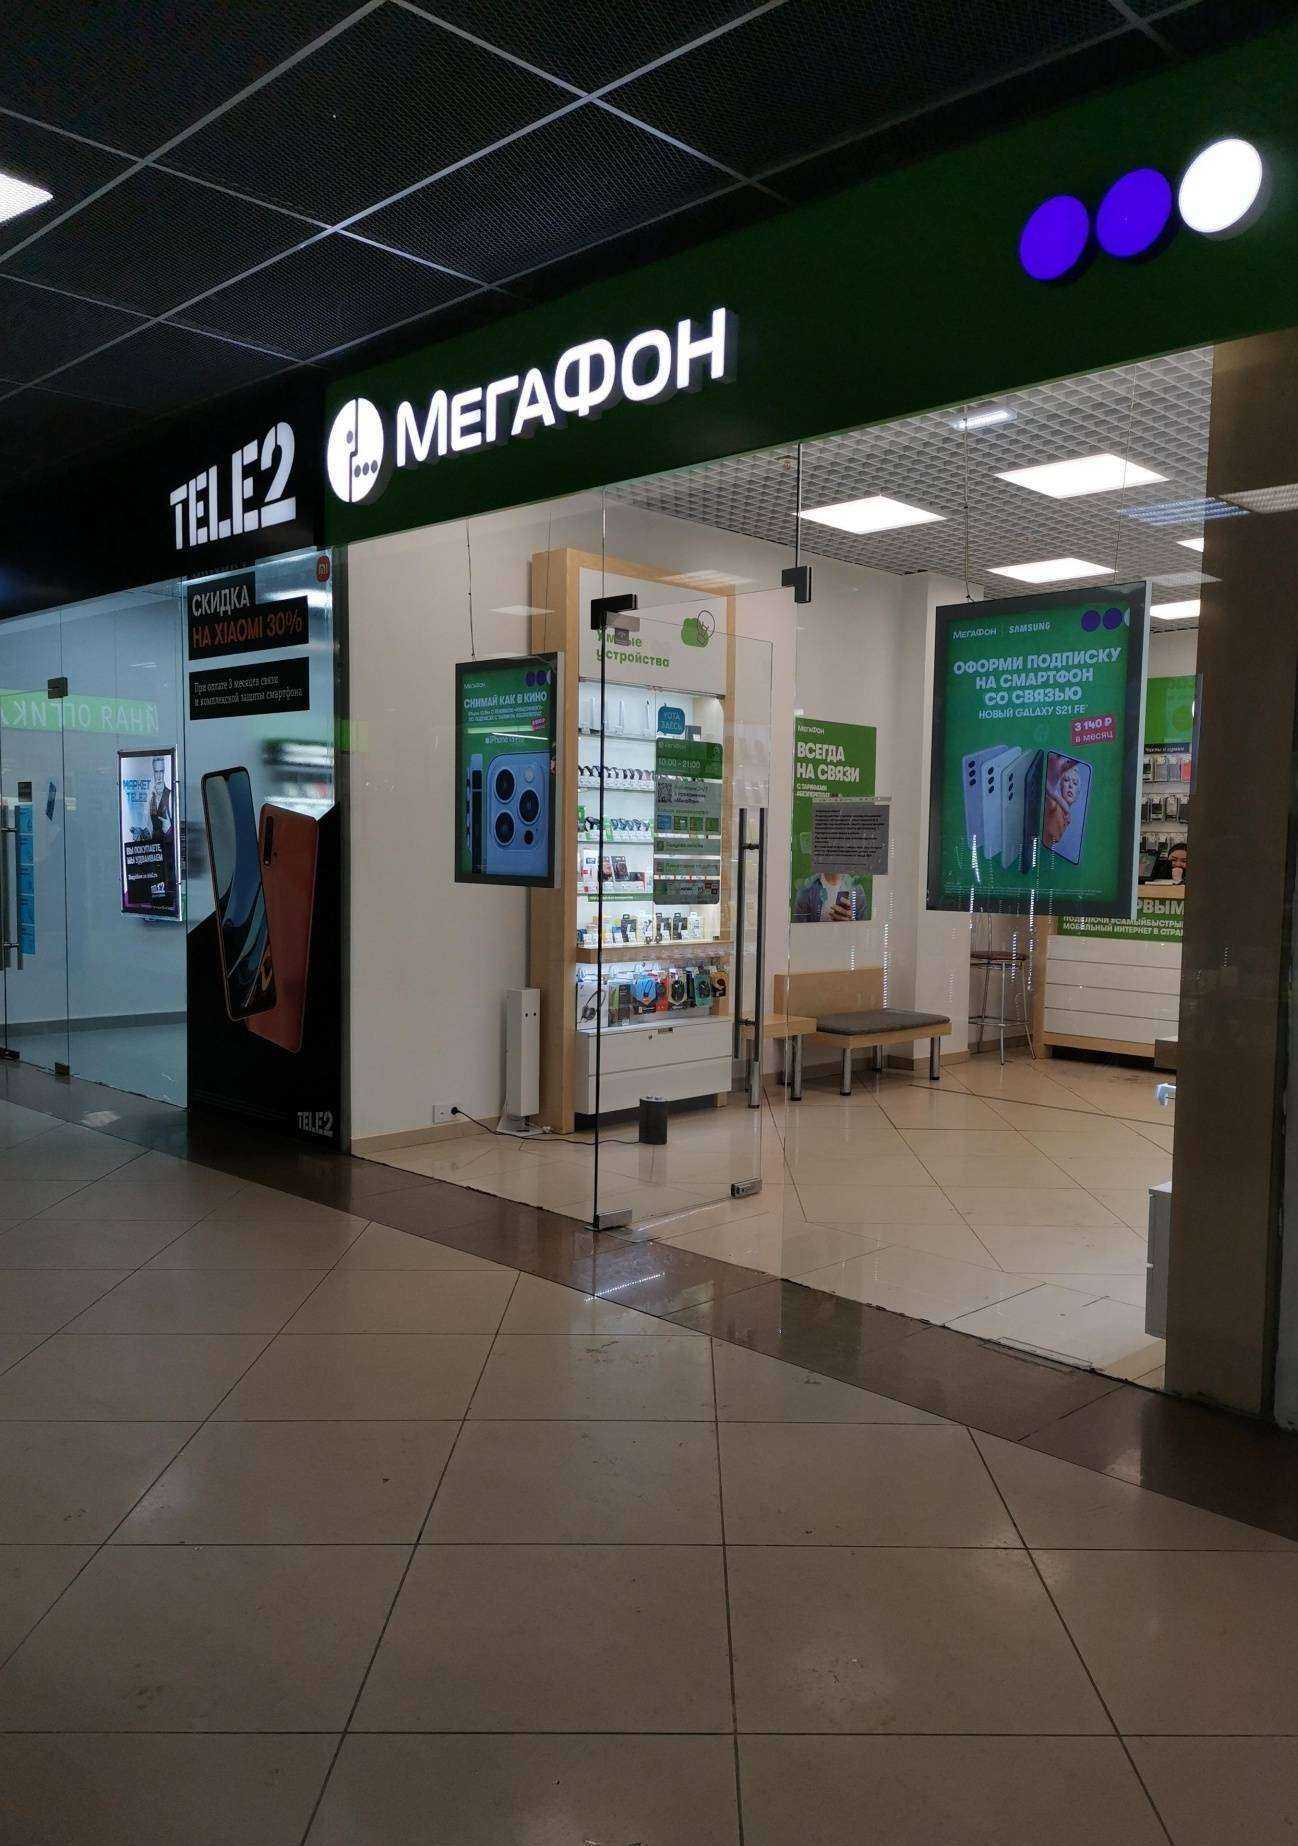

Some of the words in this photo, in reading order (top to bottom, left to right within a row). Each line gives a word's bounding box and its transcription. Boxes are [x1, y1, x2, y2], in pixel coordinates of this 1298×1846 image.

[170, 421, 296, 551] TELE2
[192, 585, 250, 616] СКИДКА
[193, 625, 211, 649] НА
[214, 615, 263, 645] XIAOMI
[267, 608, 304, 637] 30%
[1009, 621, 1050, 634] SAMSUNG
[954, 656, 1024, 675] ОФОРМИ
[1027, 647, 1121, 669] ПОДПИСКУ
[976, 675, 997, 690] НА
[1000, 667, 1094, 688] СМАРТФОН
[194, 682, 206, 696] При
[266, 686, 304, 701] смартфона
[985, 691, 1009, 706] СО
[1012, 686, 1082, 704] СВЯЗЬЮ
[464, 694, 498, 709] СНИМАЙ
[500, 694, 515, 705] КАК
[517, 694, 523, 704] В
[524, 690, 547, 703] КИНО
[979, 706, 1013, 719] НОВЫЙ
[1015, 706, 1053, 718] GALAXY
[1056, 705, 1072, 716] S21
[1074, 722, 1081, 732] 3
[1083, 718, 1103, 730] 140
[1075, 735, 1081, 743] в
[1083, 731, 1114, 742] месяц
[797, 742, 845, 763] ВСЕГДА
[796, 762, 815, 779] НА
[818, 764, 860, 783] СВЯЗИ
[1114, 924, 1152, 935] ИНТЕРНЕТ
[1153, 927, 1159, 935] В
[296, 1110, 334, 1138] TELE2
